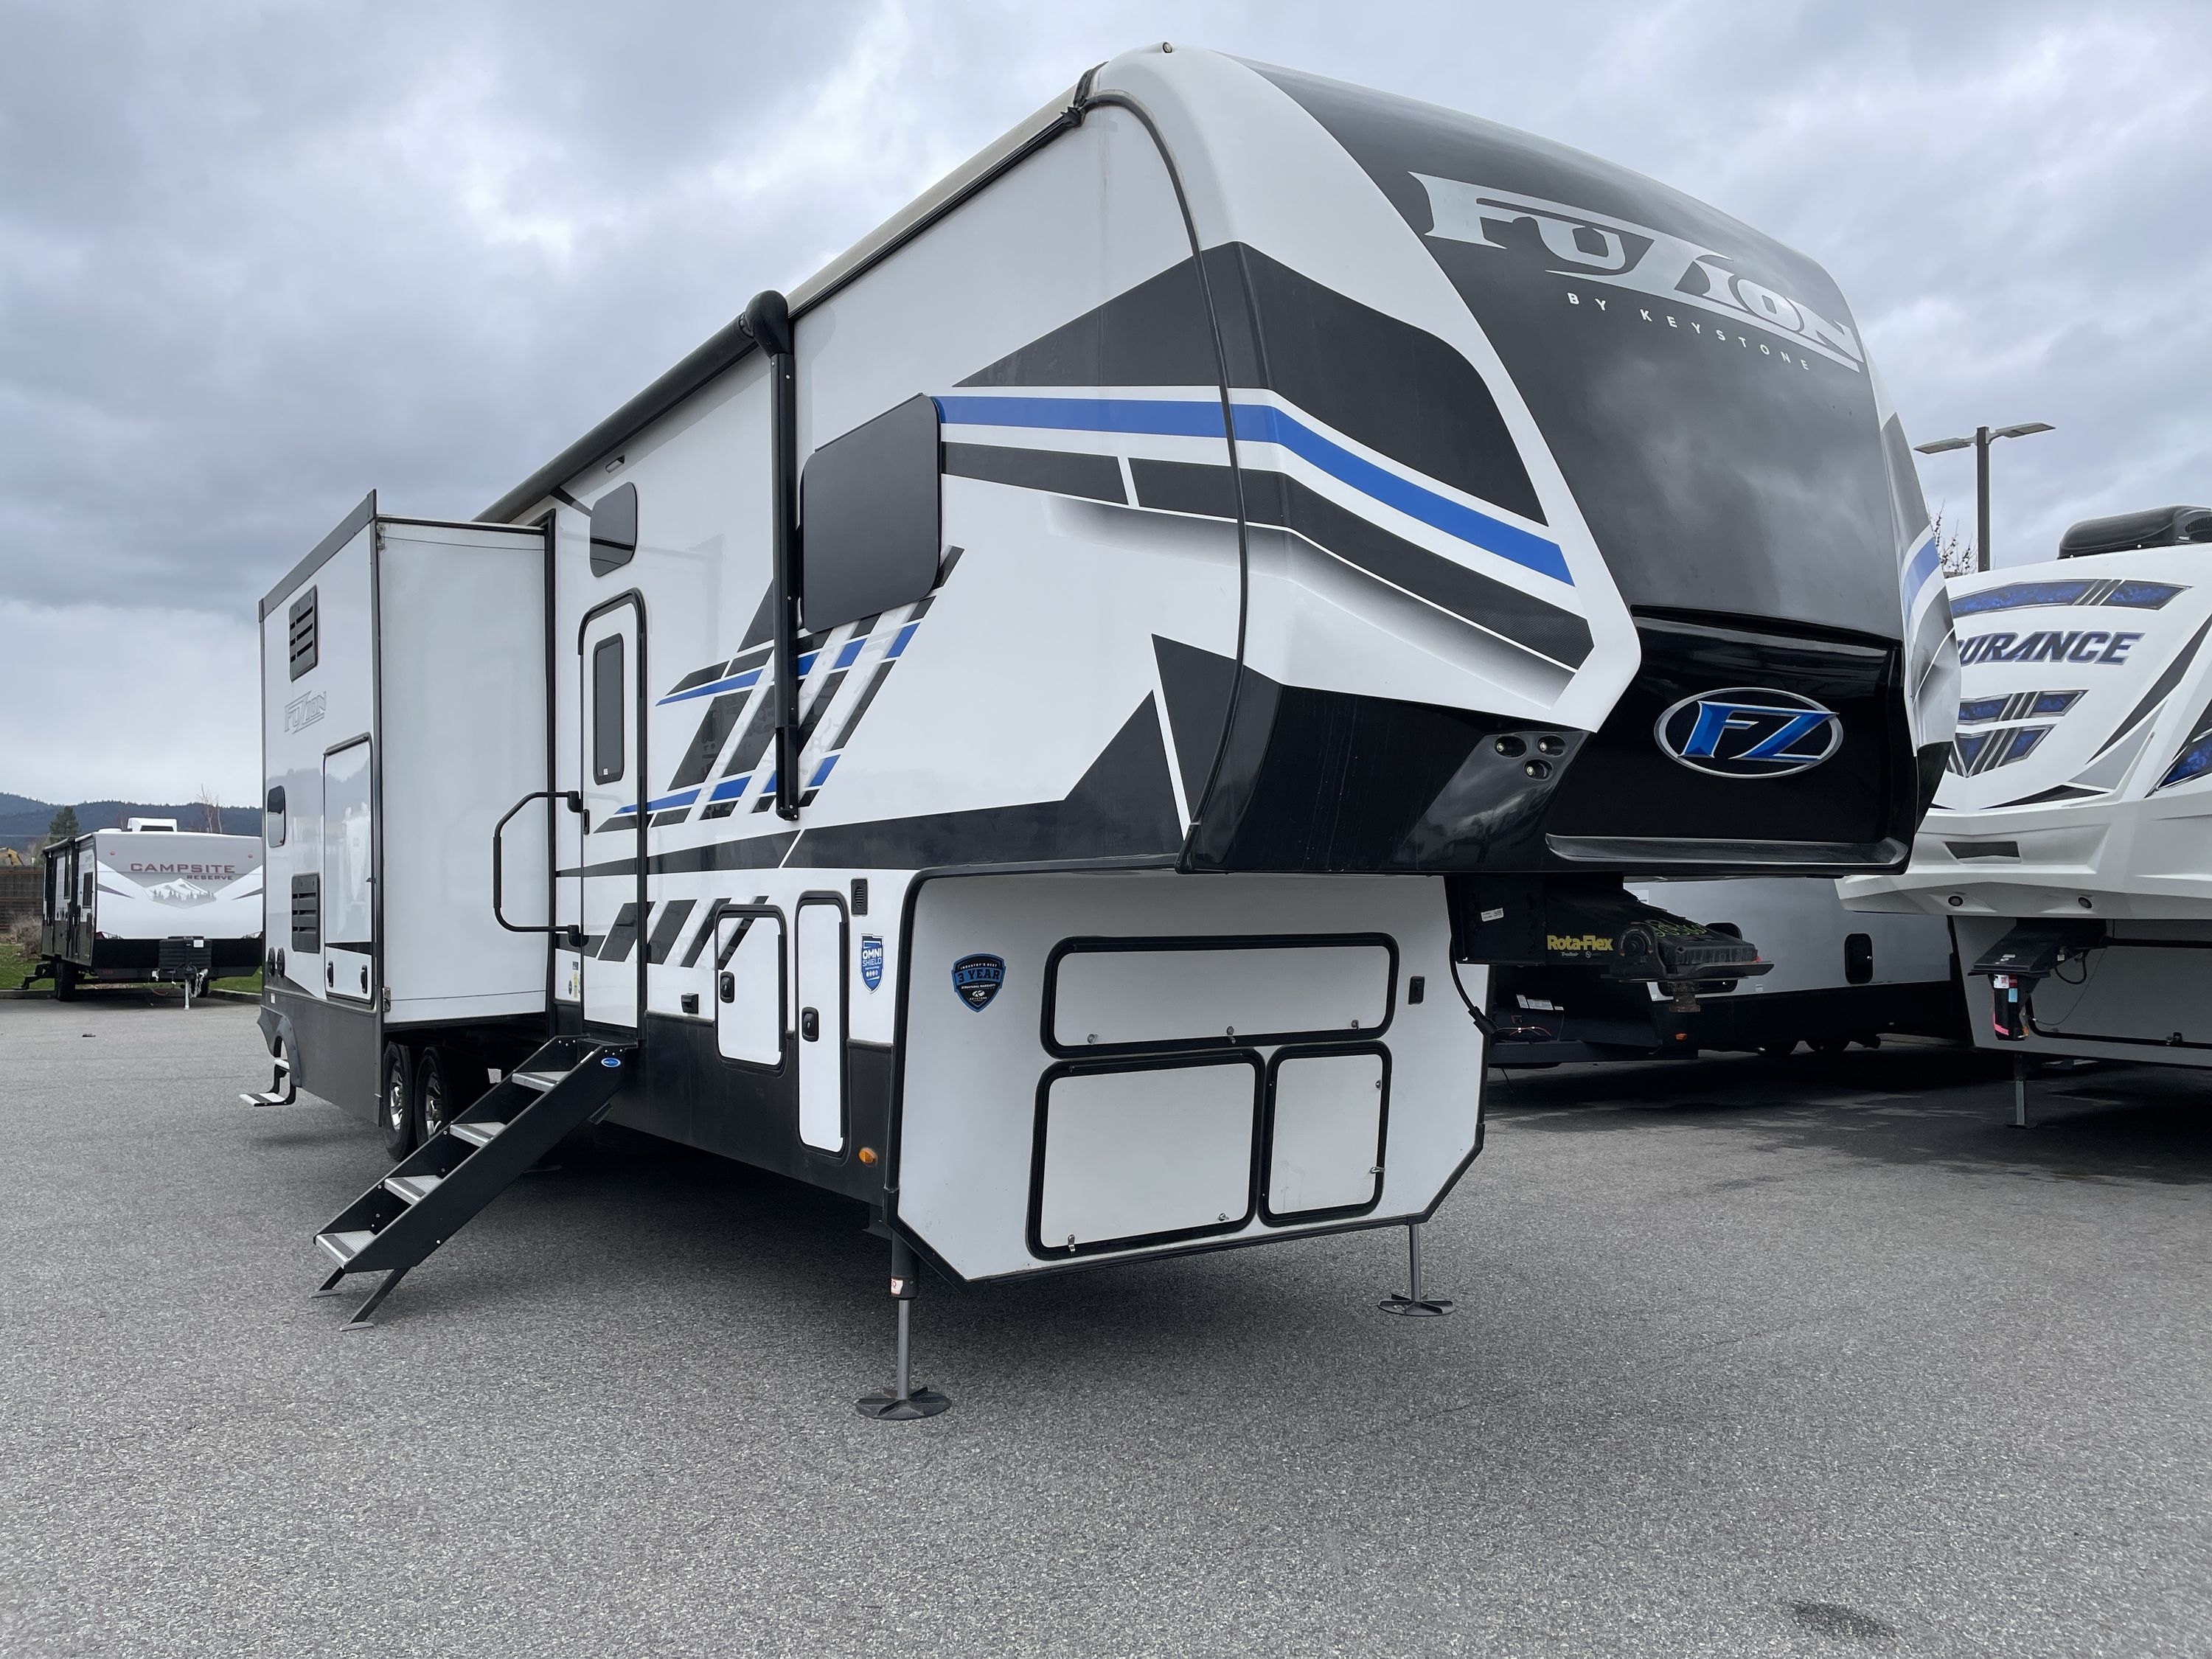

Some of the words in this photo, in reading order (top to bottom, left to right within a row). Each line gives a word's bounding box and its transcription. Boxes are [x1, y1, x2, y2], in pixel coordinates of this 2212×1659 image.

[1567, 292, 1607, 310] BY
[1639, 308, 1809, 370] KEYSTONE
[1958, 630, 2146, 667] URANCE
[1676, 700, 1840, 763] FZ
[130, 863, 235, 874] CAMPSITE
[863, 947, 882, 959] OMNI
[863, 957, 882, 967] SHIELD
[958, 973, 965, 984] 3
[967, 968, 1000, 981] YEAR
